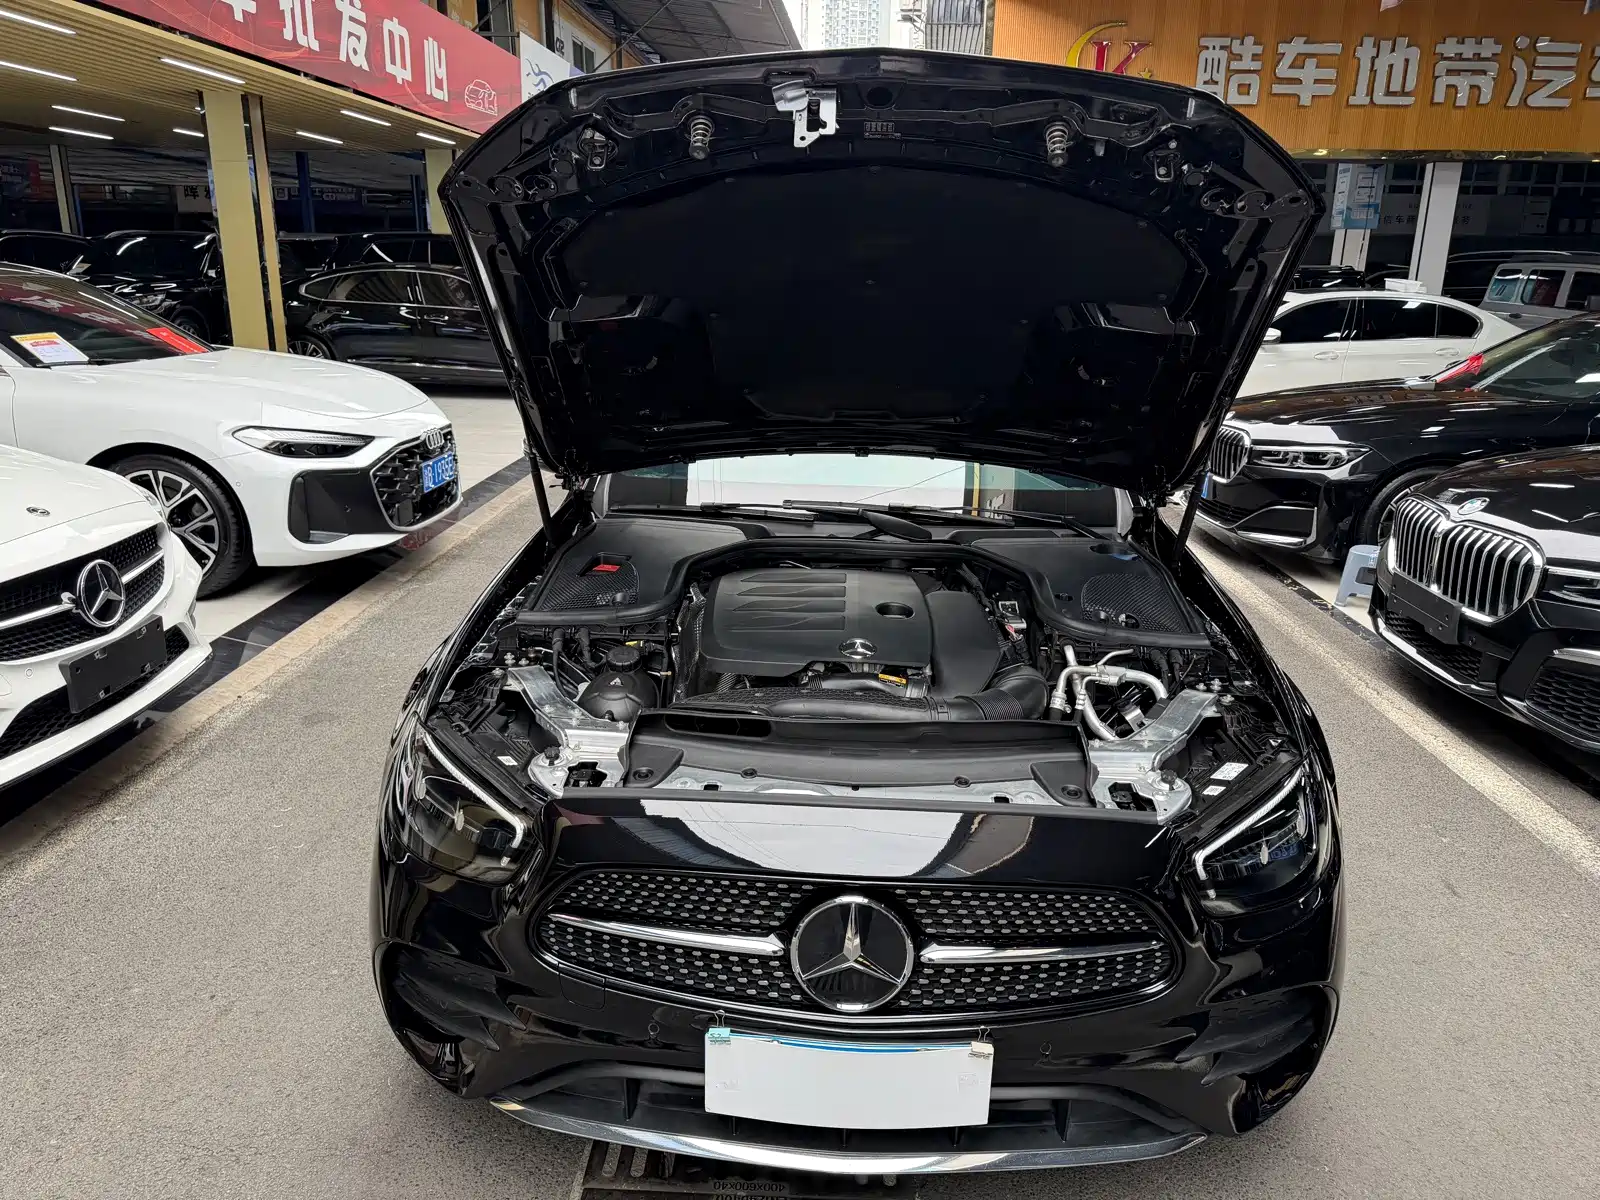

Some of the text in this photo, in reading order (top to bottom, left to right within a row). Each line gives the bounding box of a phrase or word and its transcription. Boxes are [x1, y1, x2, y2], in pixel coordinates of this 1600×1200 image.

[1195, 36, 1600, 107] 酷车地带汽
